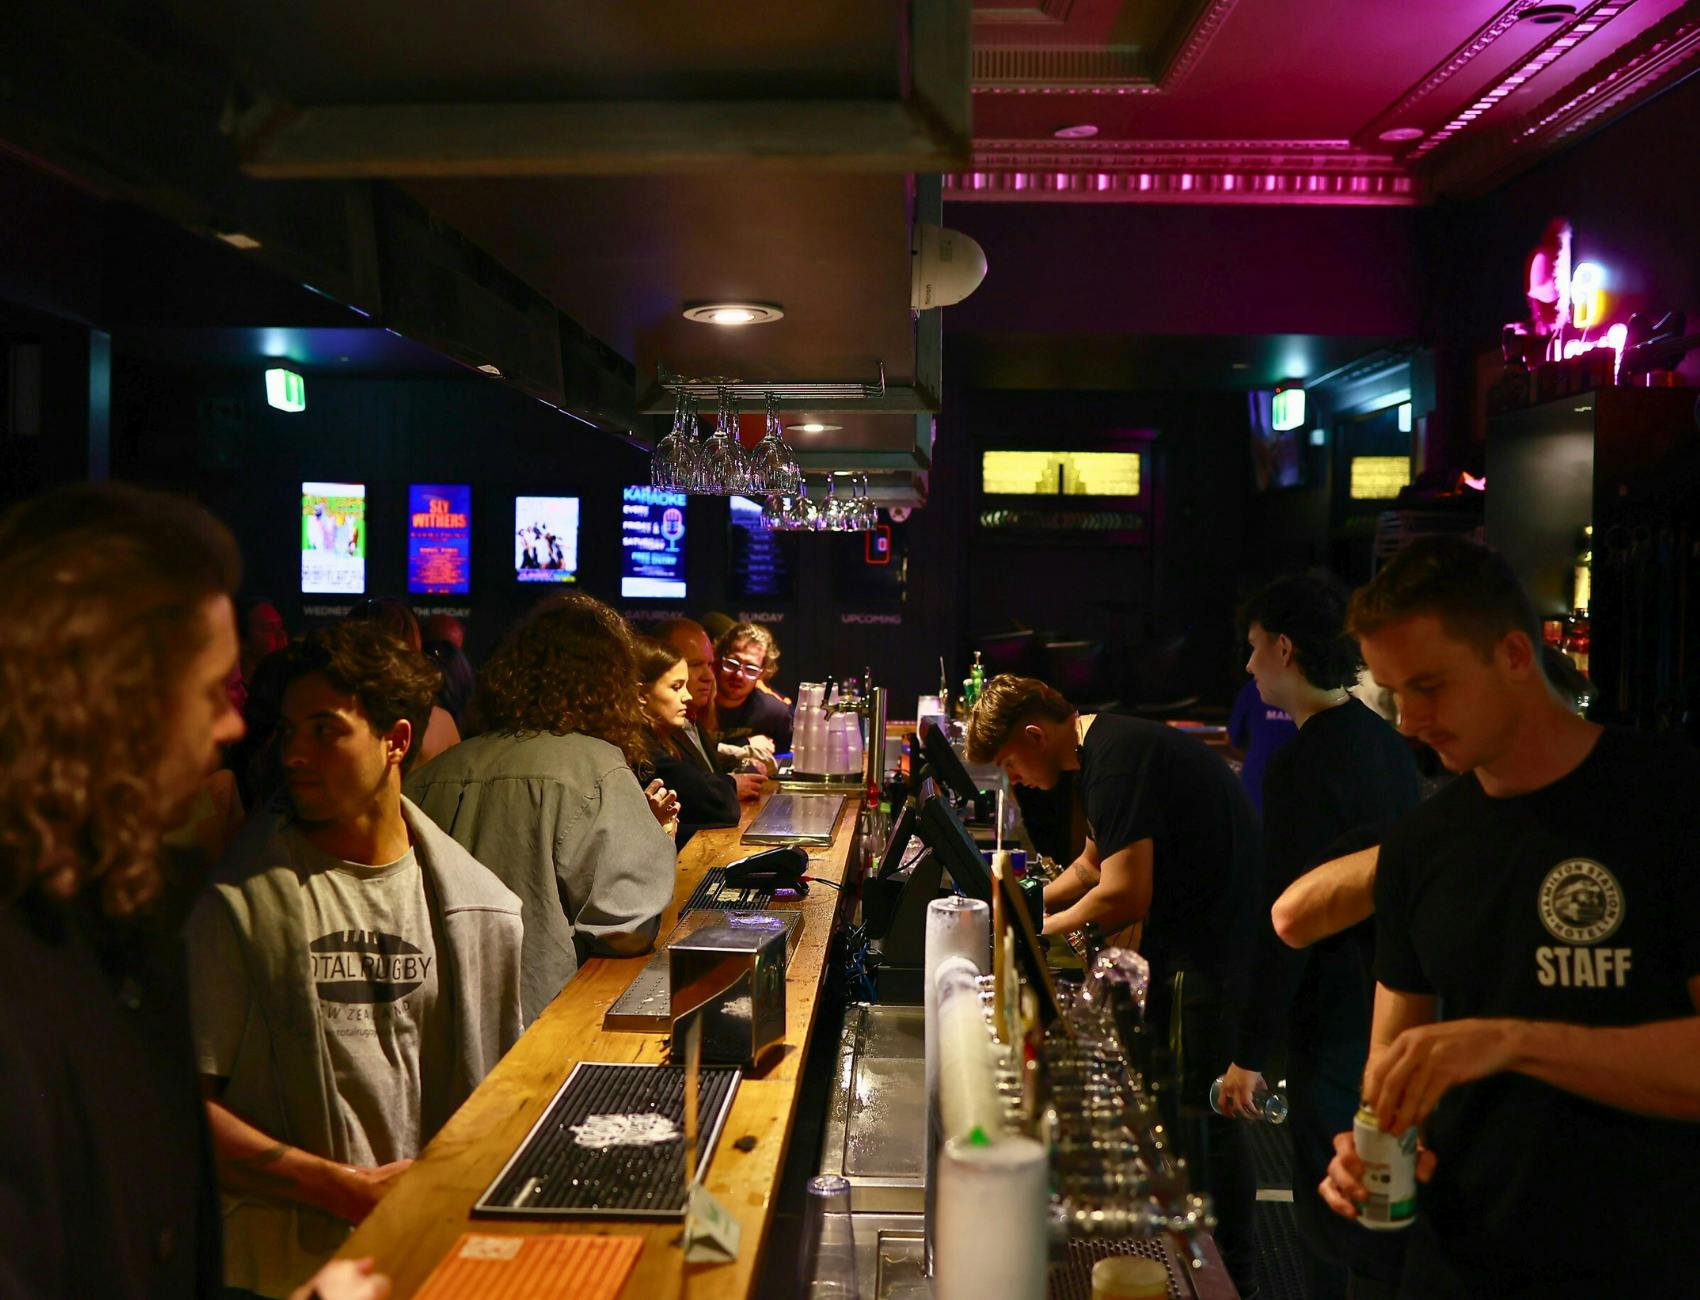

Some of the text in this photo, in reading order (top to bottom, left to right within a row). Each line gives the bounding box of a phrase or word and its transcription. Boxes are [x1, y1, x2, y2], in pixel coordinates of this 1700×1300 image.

[623, 487, 687, 506] KARAOKE
[412, 512, 467, 528] WITHERS
[738, 610, 785, 622] SUNDAY
[841, 613, 902, 625] UPCOMING
[1542, 862, 1618, 919] HAMILTON STATION
[1553, 922, 1606, 940] HOTEL
[361, 956, 433, 981] RUGBY
[1535, 945, 1633, 988] STAFF
